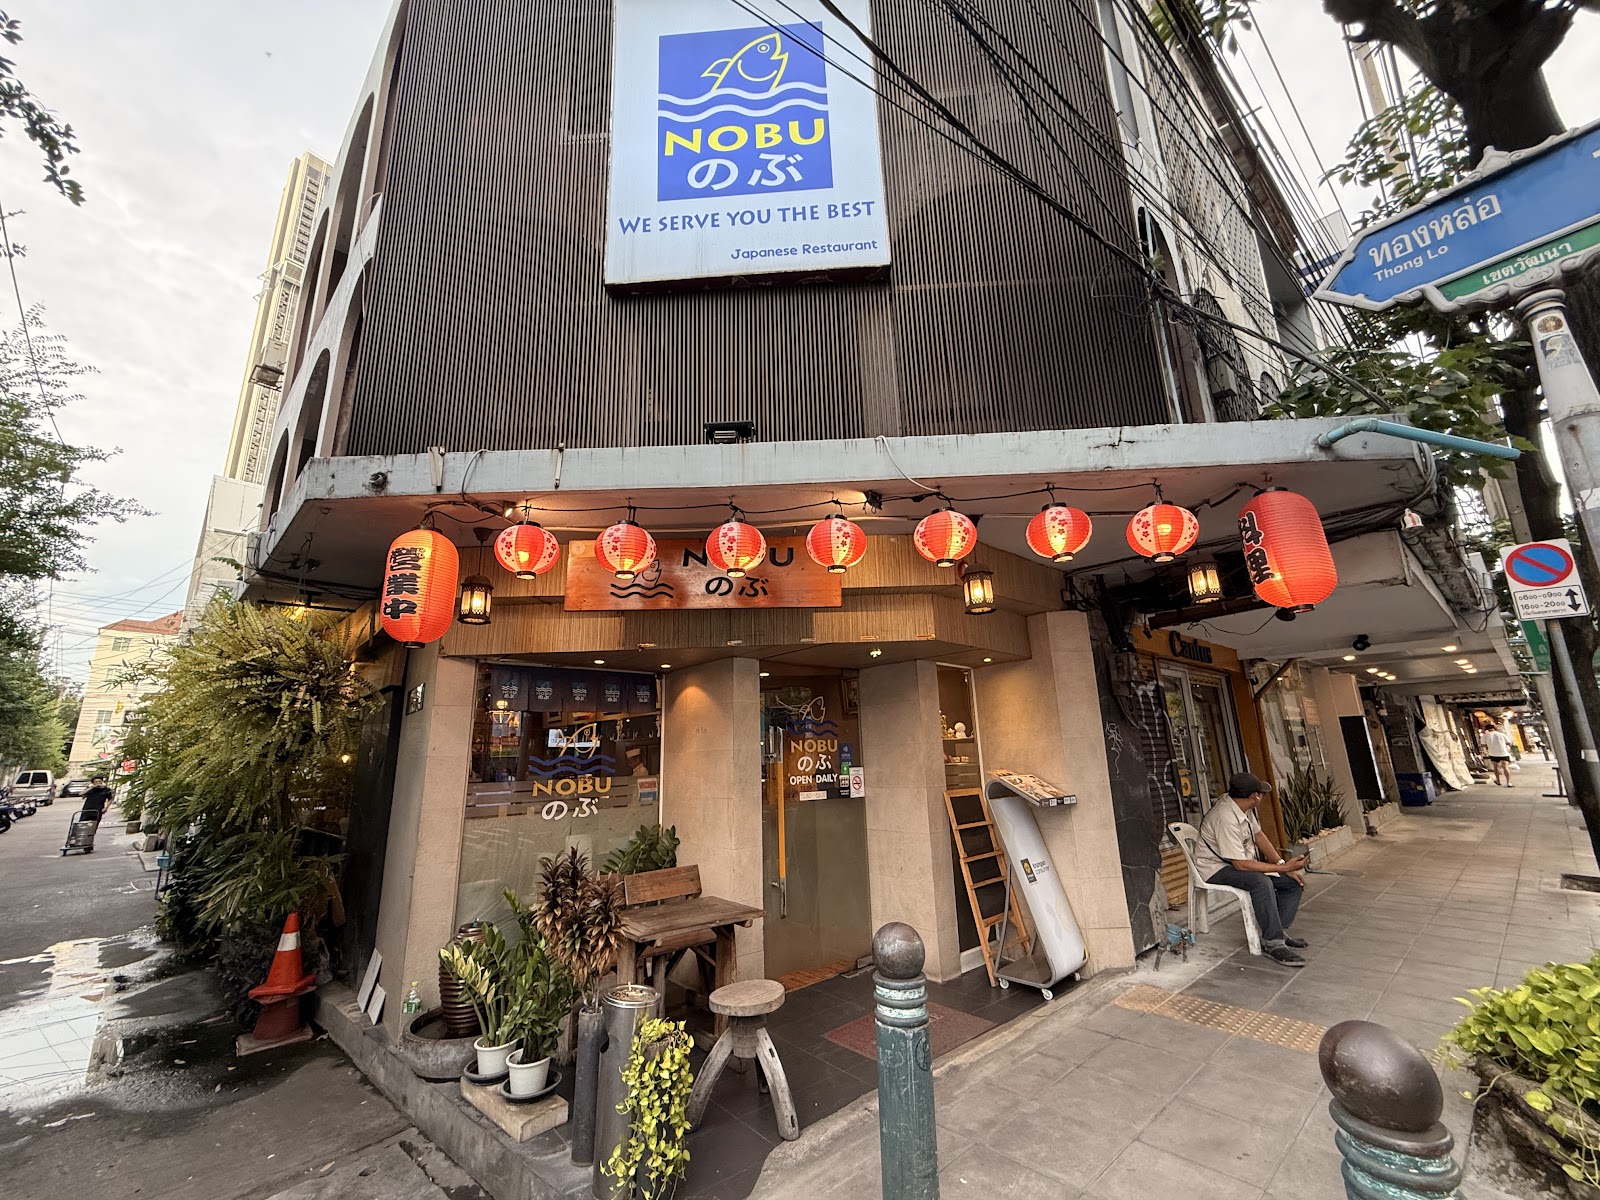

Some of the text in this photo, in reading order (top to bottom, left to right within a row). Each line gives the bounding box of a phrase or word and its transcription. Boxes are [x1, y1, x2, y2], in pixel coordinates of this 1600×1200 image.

[664, 118, 825, 156] NOBU
[687, 152, 804, 190] のぶ
[618, 200, 876, 235] WE SERVE YOU THE BEST
[1368, 194, 1502, 268] ทองหล่อ
[731, 239, 878, 260] Japanese Restaurant
[1373, 244, 1449, 282] Thong Lo
[1482, 242, 1573, 285] เขตวัฒนา
[682, 547, 794, 567] NU
[705, 576, 770, 597] のぶ
[791, 739, 838, 753] NOBU
[797, 753, 832, 772] のぶ
[532, 776, 612, 797] NOBU
[790, 773, 837, 785] OPEN DAILY
[541, 797, 599, 821] のぶ
